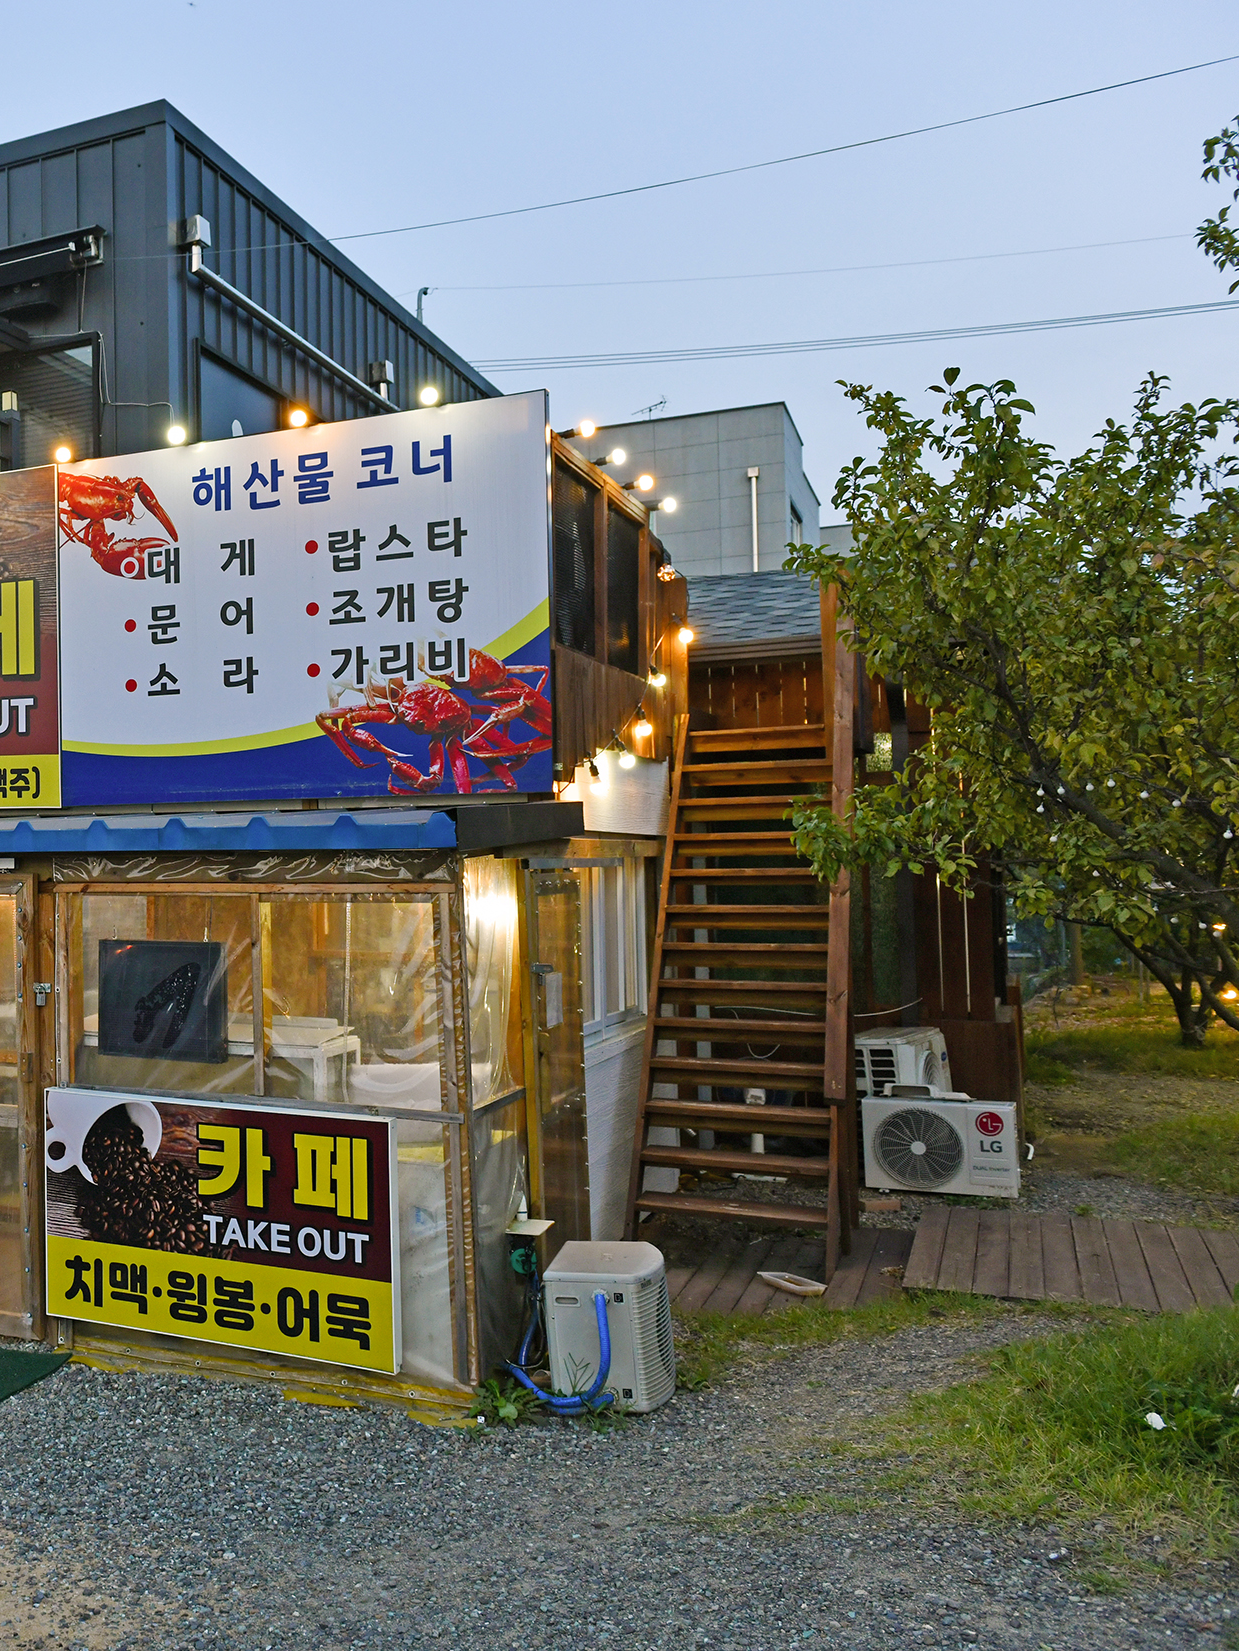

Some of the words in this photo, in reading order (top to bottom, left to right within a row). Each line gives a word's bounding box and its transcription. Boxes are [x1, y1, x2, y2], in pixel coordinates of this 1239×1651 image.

[192, 451, 334, 512] 해산물
[356, 434, 453, 490] 코너
[327, 516, 468, 573] 랍스타
[328, 578, 470, 626] 조개탕
[330, 637, 467, 686] 가리비
[197, 1122, 371, 1221] 카페
[980, 1140, 1003, 1154] LG
[203, 1214, 292, 1254] TAKE
[297, 1228, 371, 1264] OUT
